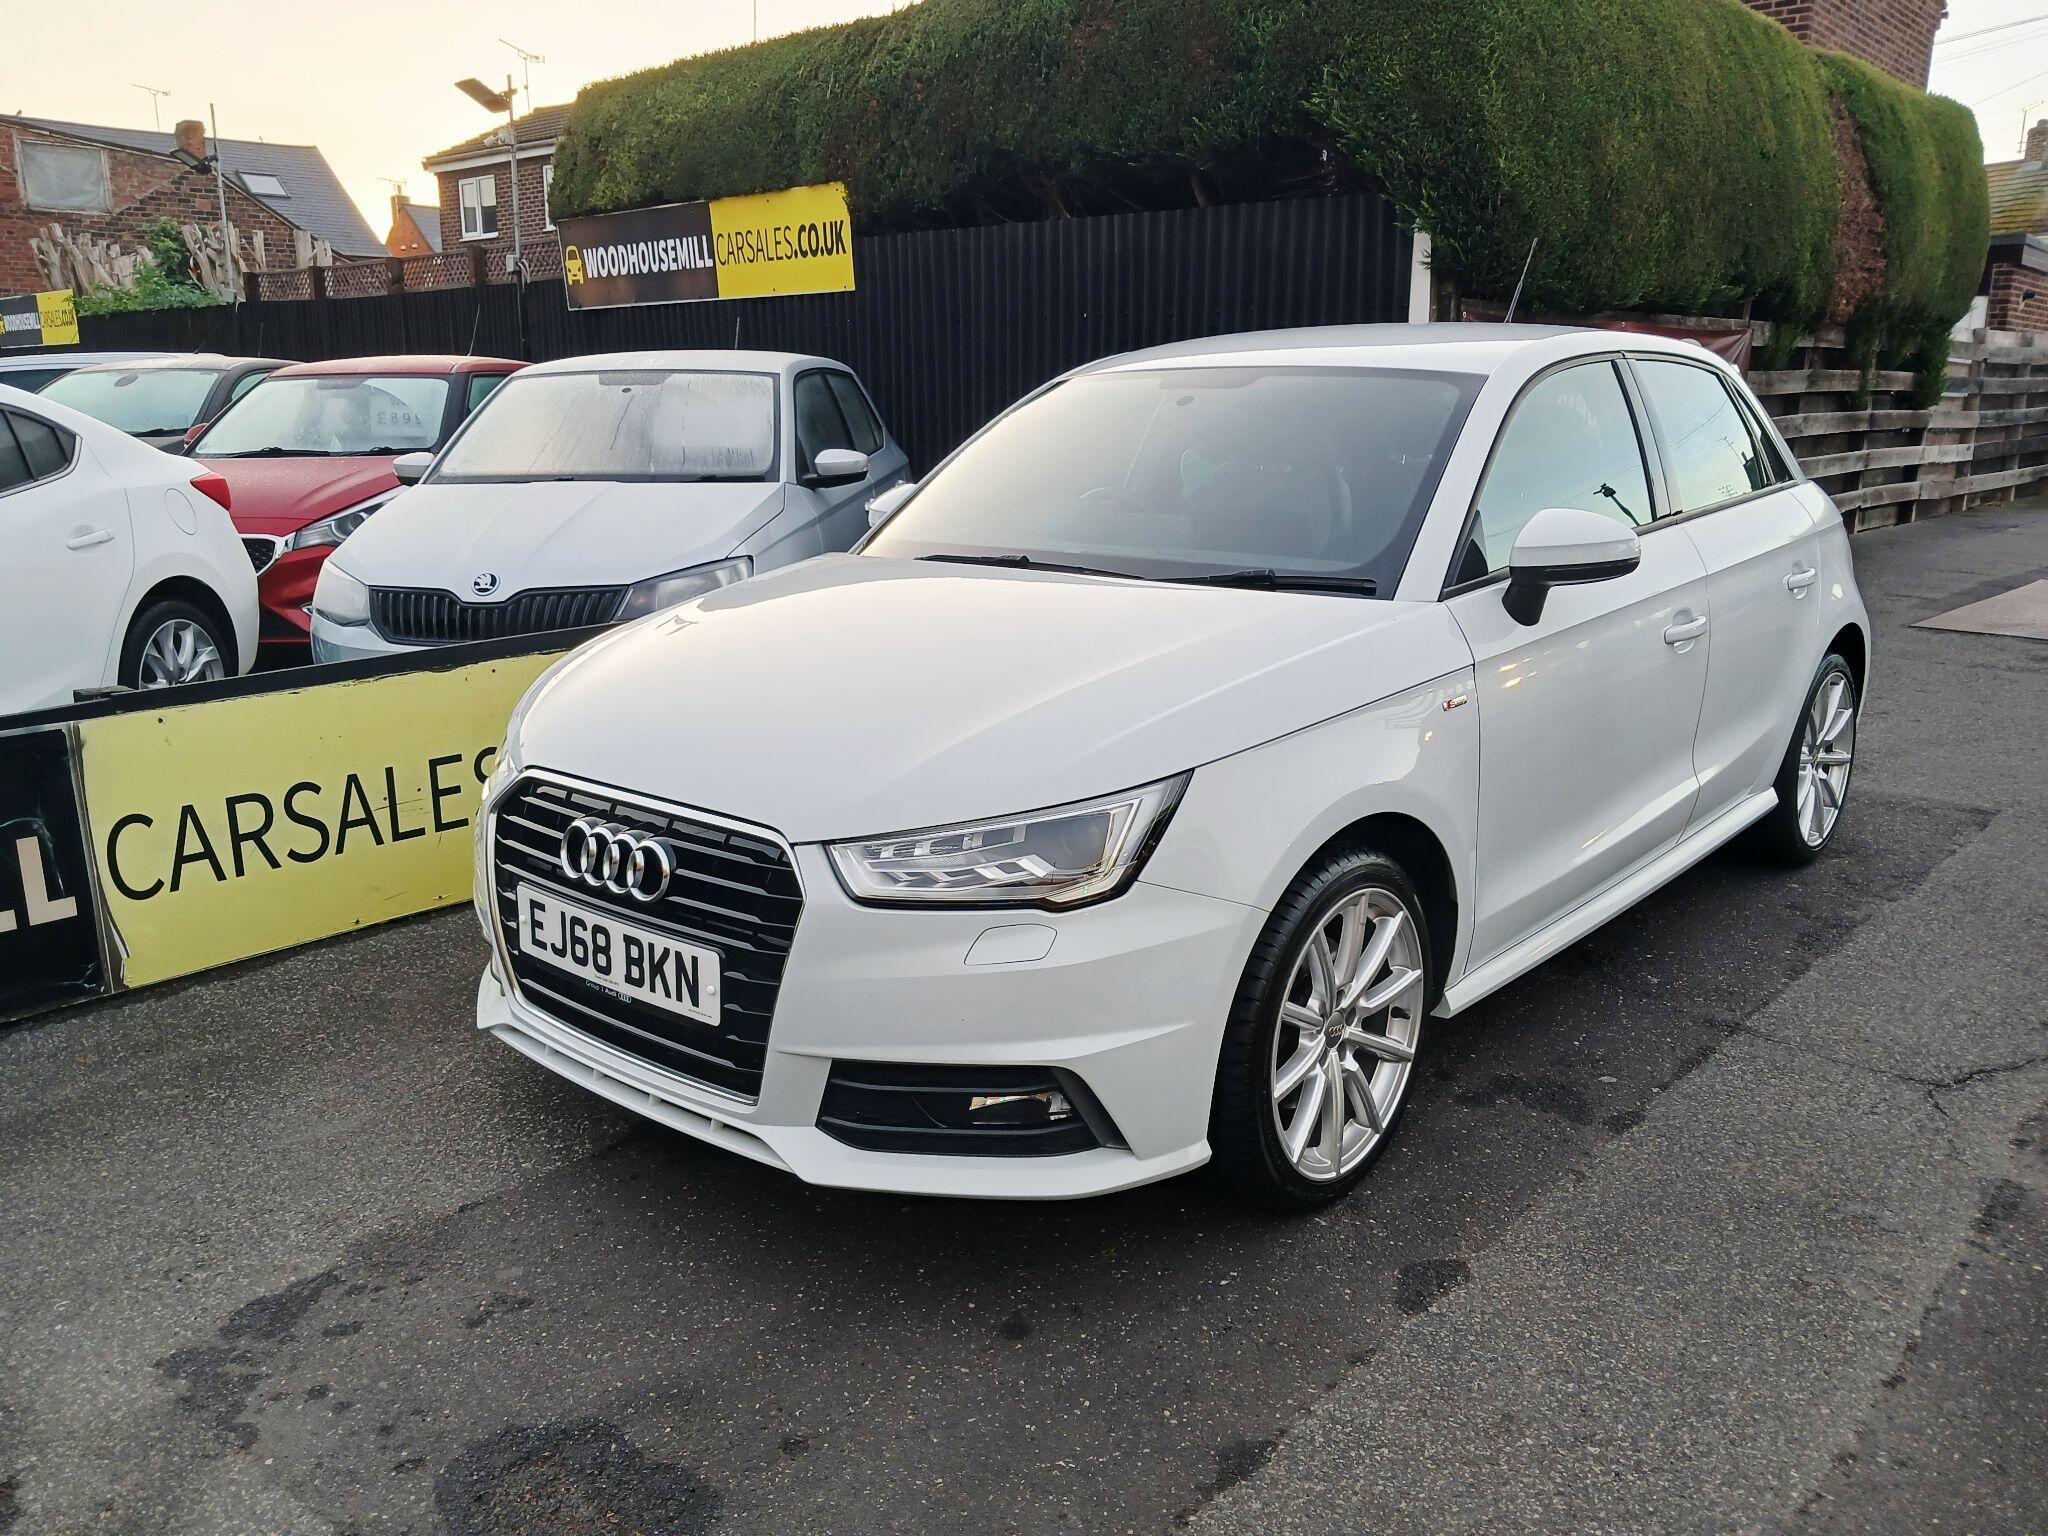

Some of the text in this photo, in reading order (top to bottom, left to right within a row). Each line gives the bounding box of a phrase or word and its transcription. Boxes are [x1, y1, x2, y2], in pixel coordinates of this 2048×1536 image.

[583, 220, 847, 279] WOODHOUSEMILL CARSALES.CO.UK
[529, 898, 700, 1009] EJ68 BKN
